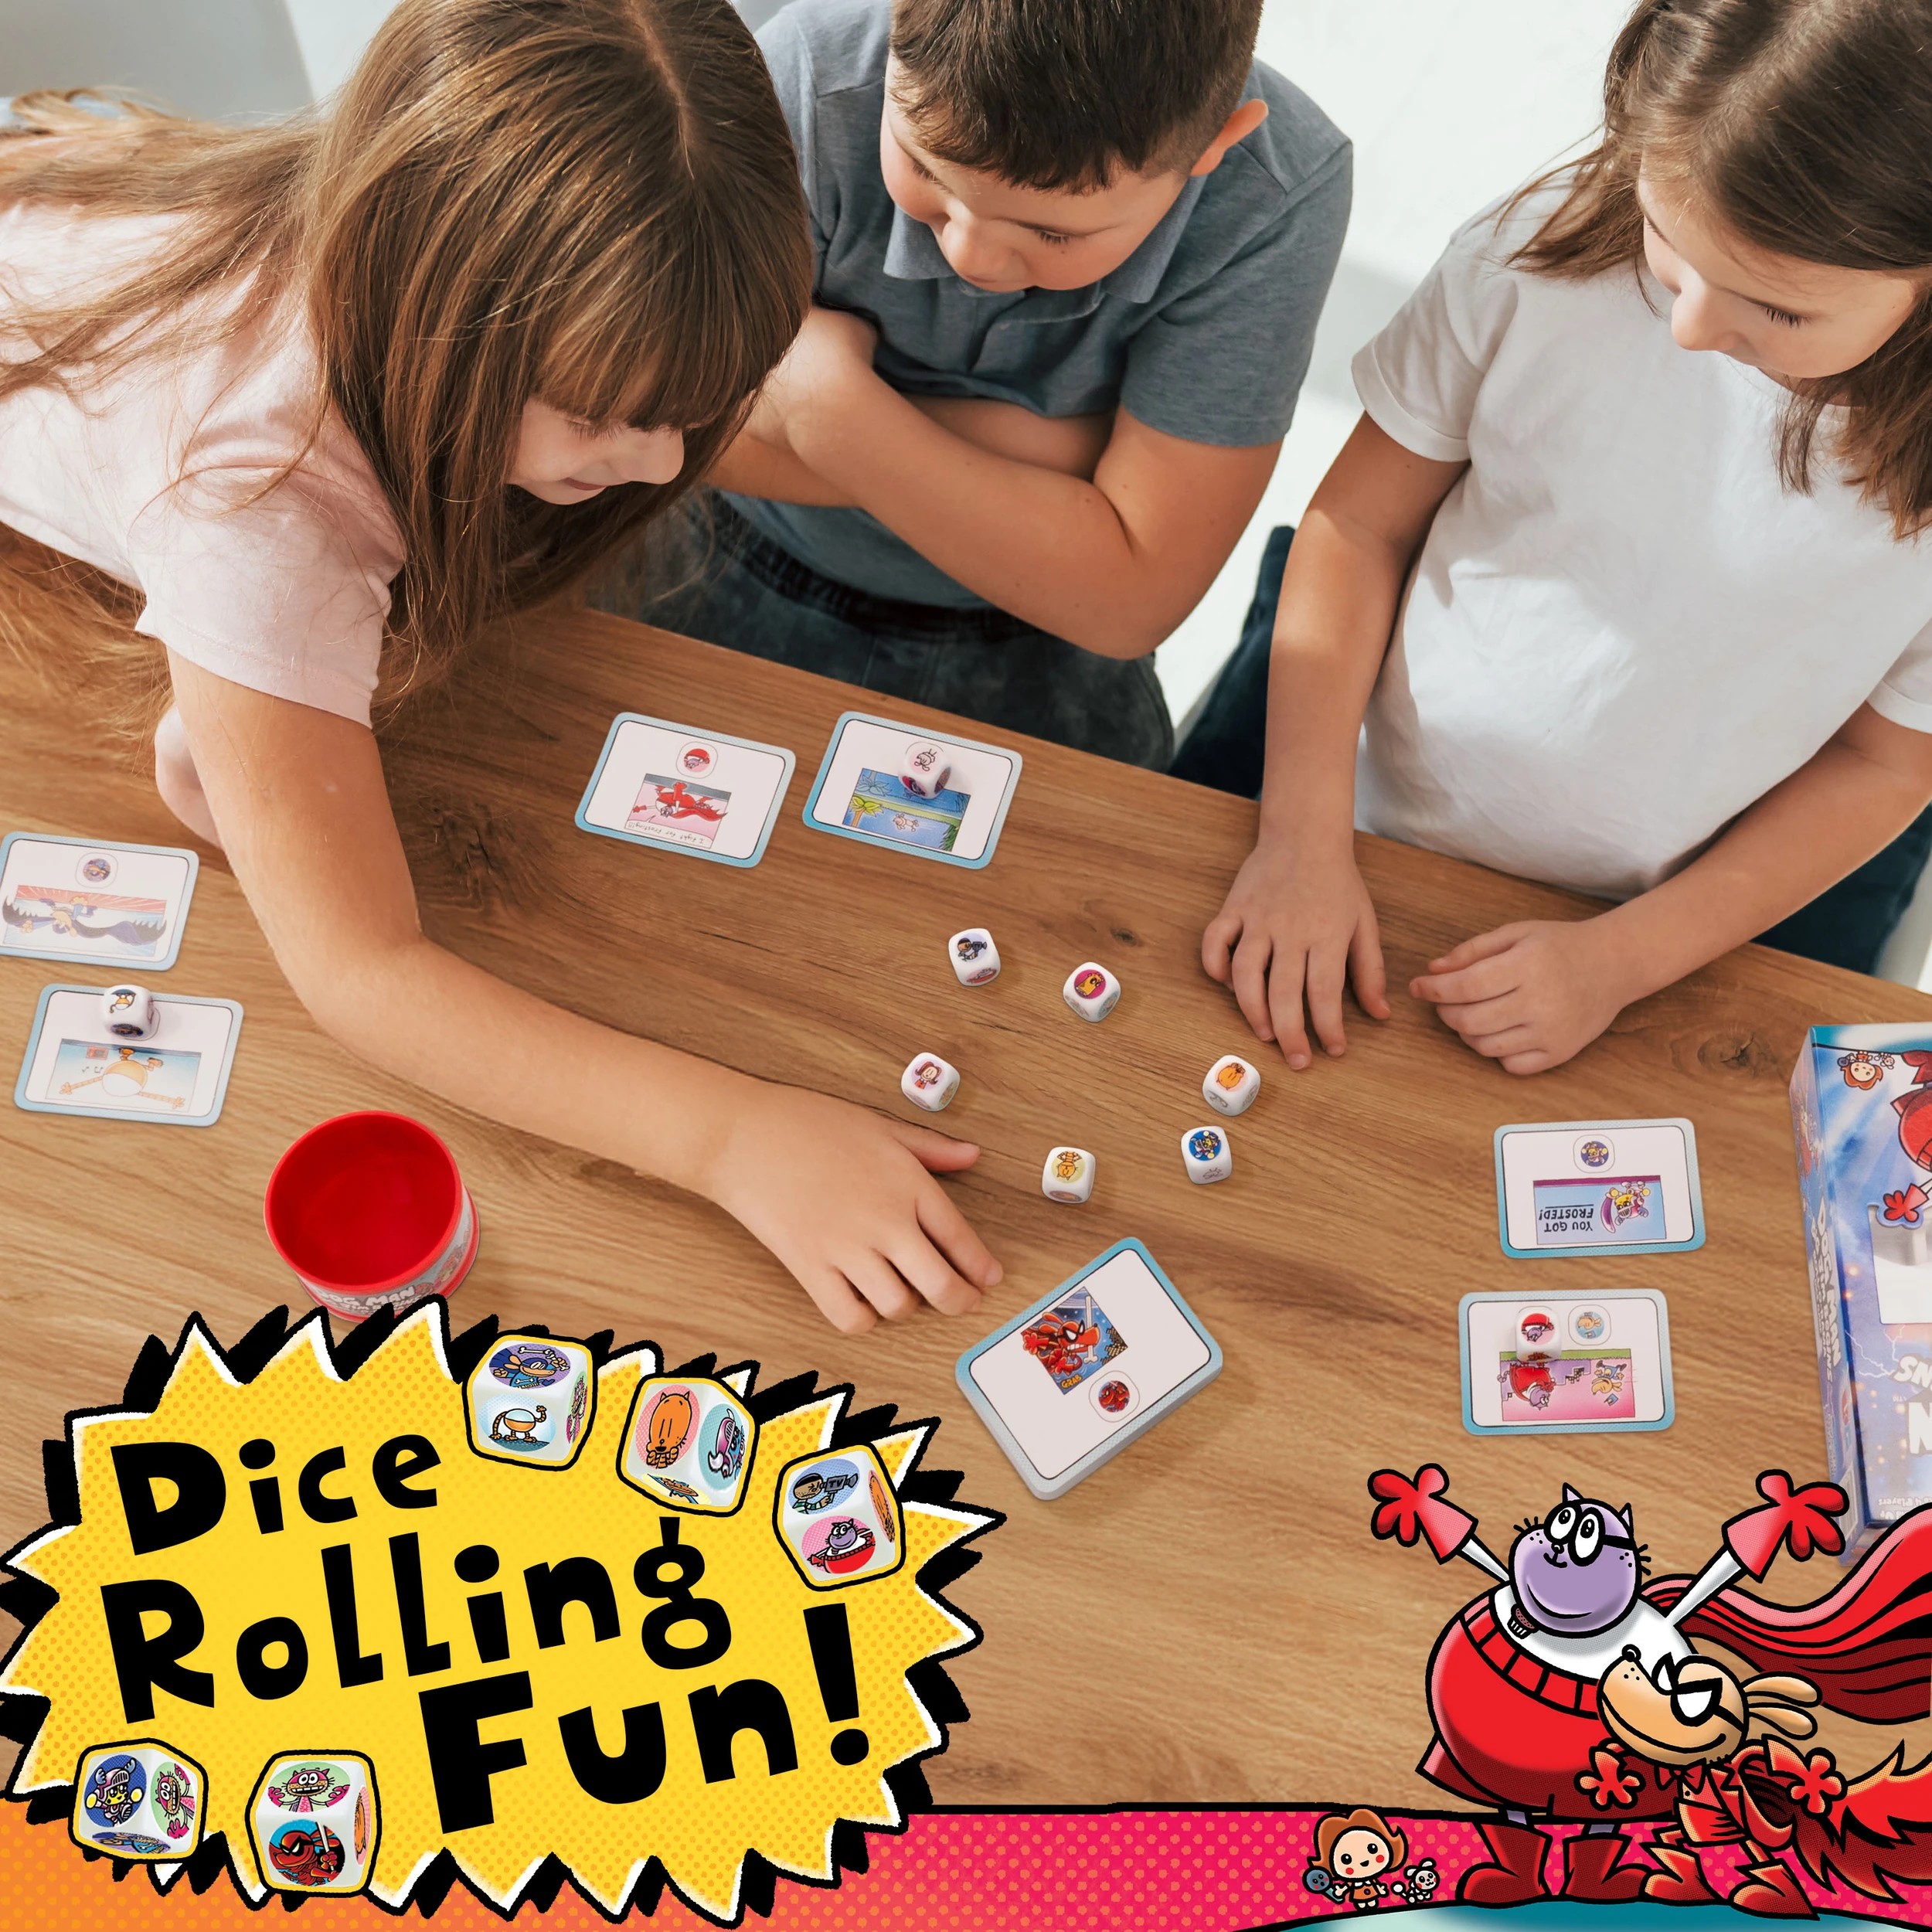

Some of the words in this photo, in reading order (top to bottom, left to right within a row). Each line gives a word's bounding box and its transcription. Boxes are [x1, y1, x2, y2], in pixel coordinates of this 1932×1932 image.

[1538, 1207, 1594, 1221] FROSTED!
[1544, 1221, 1568, 1233] GOT
[1571, 1221, 1594, 1232] YOU
[366, 1286, 415, 1305] MAN
[1060, 1373, 1083, 1389] GRAB
[1878, 1497, 1913, 1507] Players
